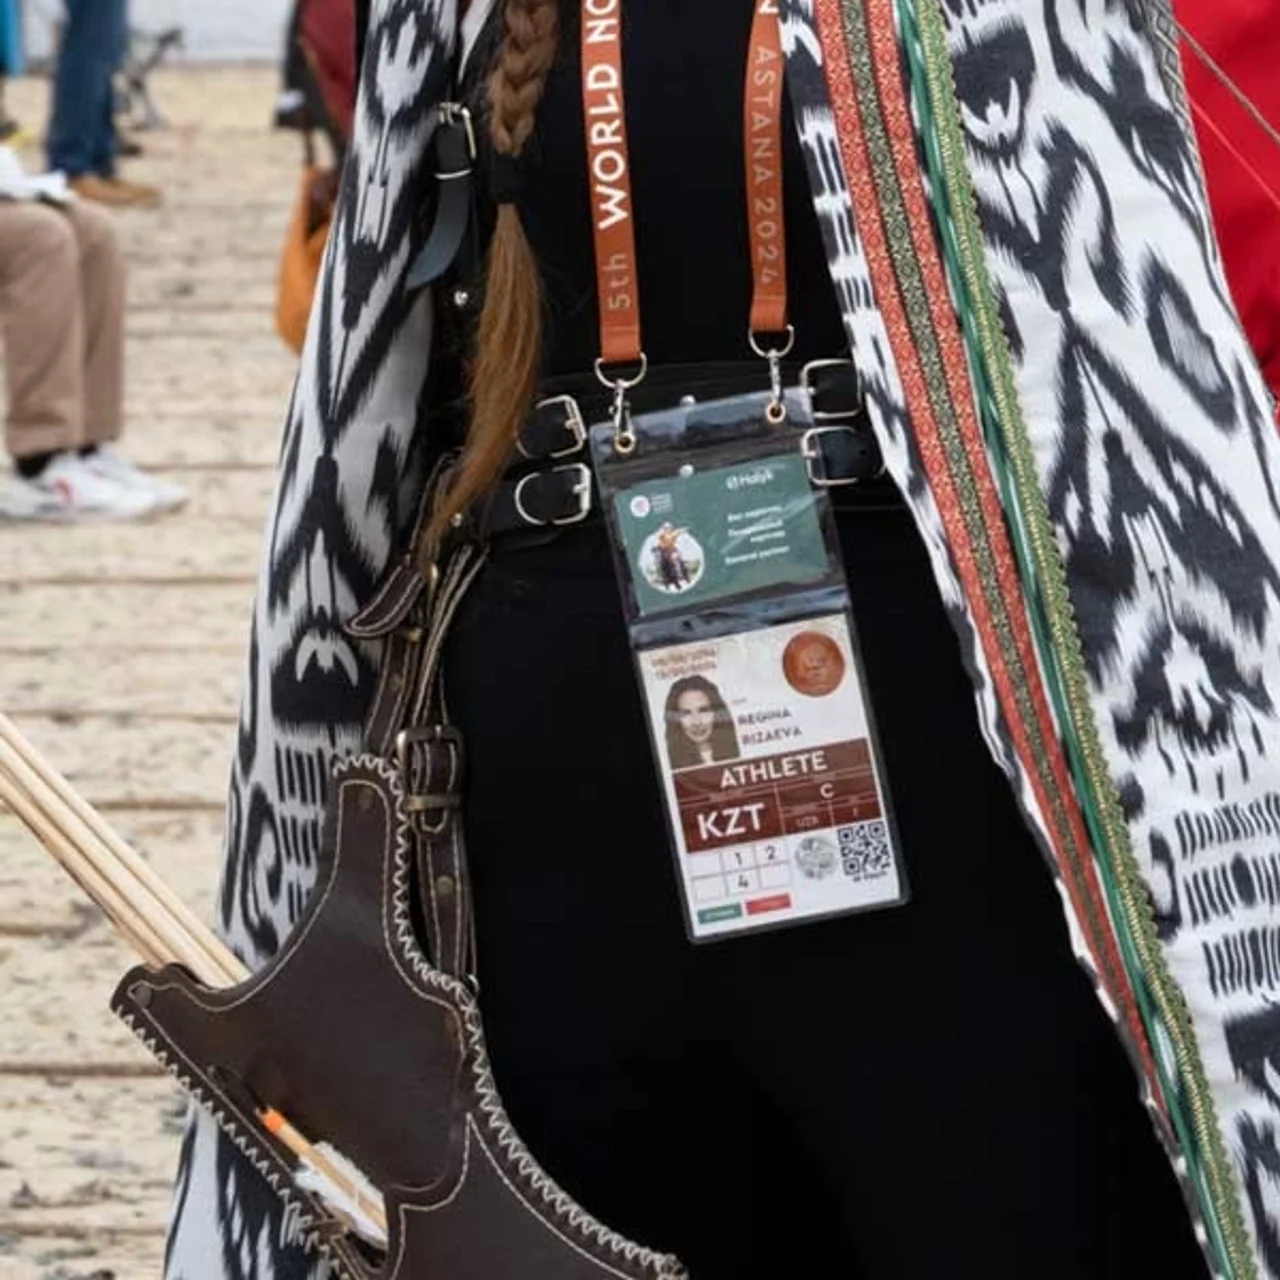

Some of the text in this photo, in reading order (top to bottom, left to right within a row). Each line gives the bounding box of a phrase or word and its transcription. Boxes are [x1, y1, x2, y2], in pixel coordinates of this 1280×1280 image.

[751, 45, 778, 184] ASTANA
[586, 63, 629, 230] WORLD
[754, 196, 778, 284] 2024
[603, 253, 631, 309] 5th
[741, 727, 803, 745] RIZAEVA
[720, 750, 829, 789] ATHLETE
[819, 783, 835, 799] C
[697, 802, 766, 841] KZT
[734, 845, 776, 866] 1 2
